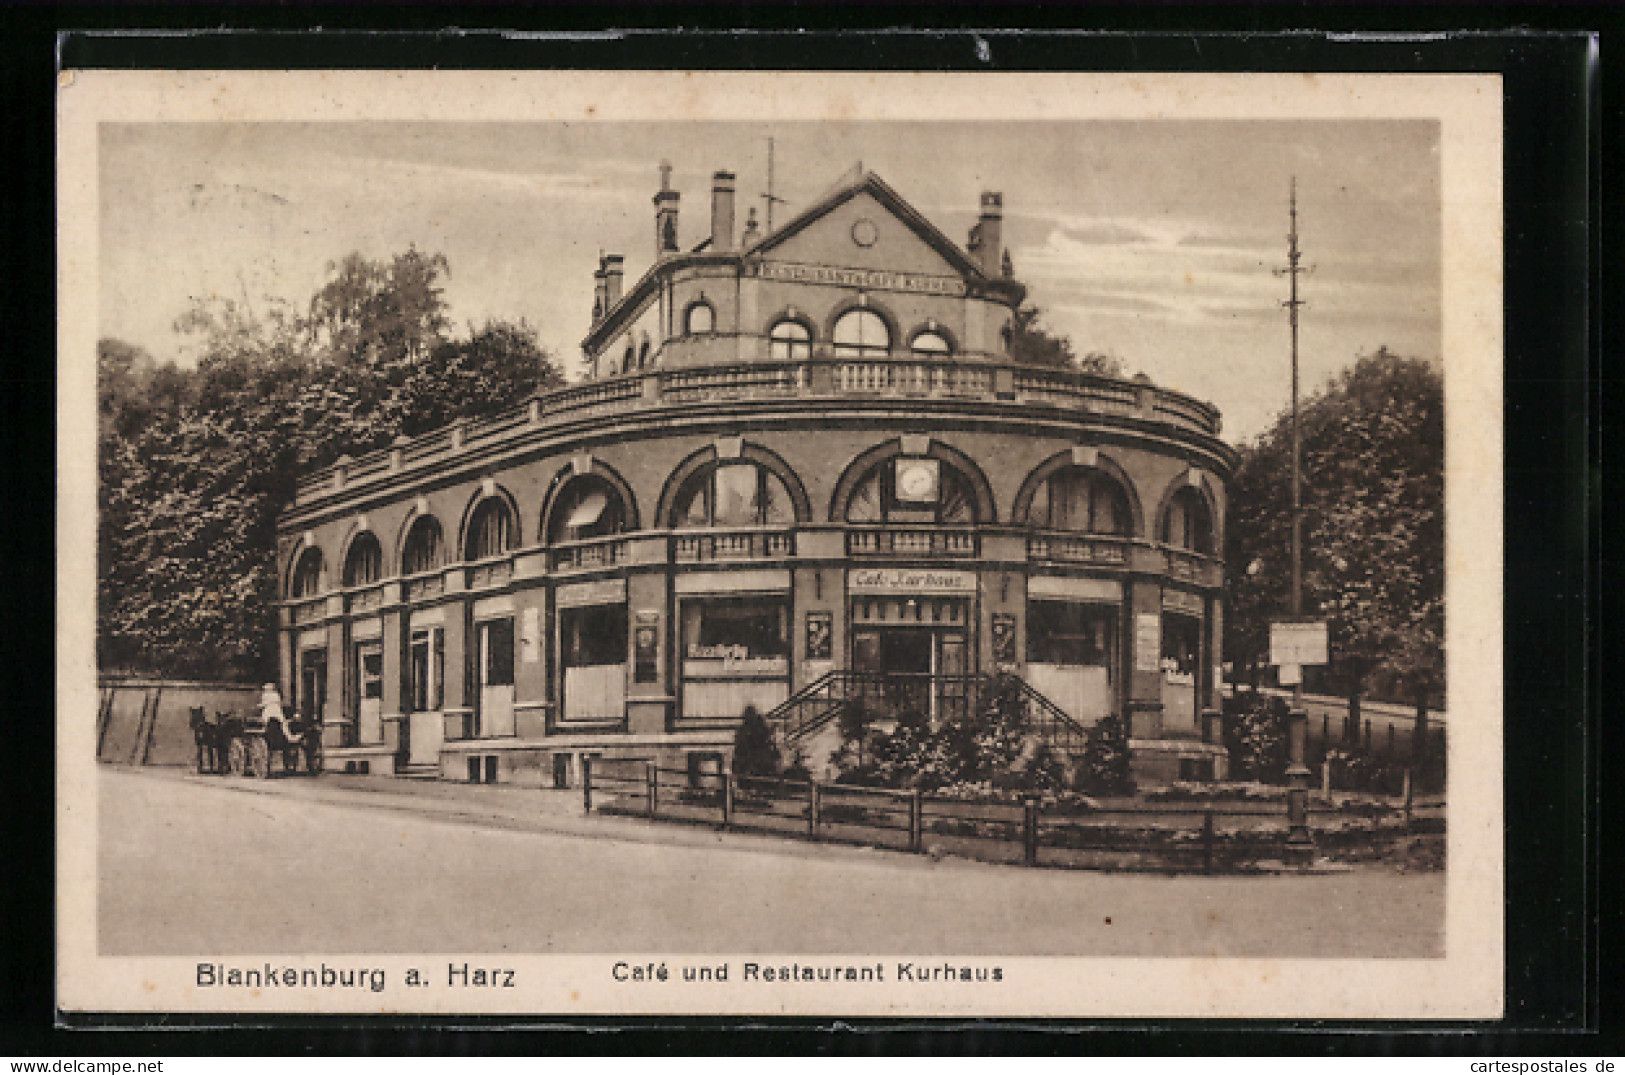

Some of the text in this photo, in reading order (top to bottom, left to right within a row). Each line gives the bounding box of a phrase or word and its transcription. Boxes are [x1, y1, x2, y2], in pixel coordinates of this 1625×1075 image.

[196, 963, 515, 993] Blankenburg a. Harz
[612, 963, 1004, 983] Café und Restaurant Kurhaus
